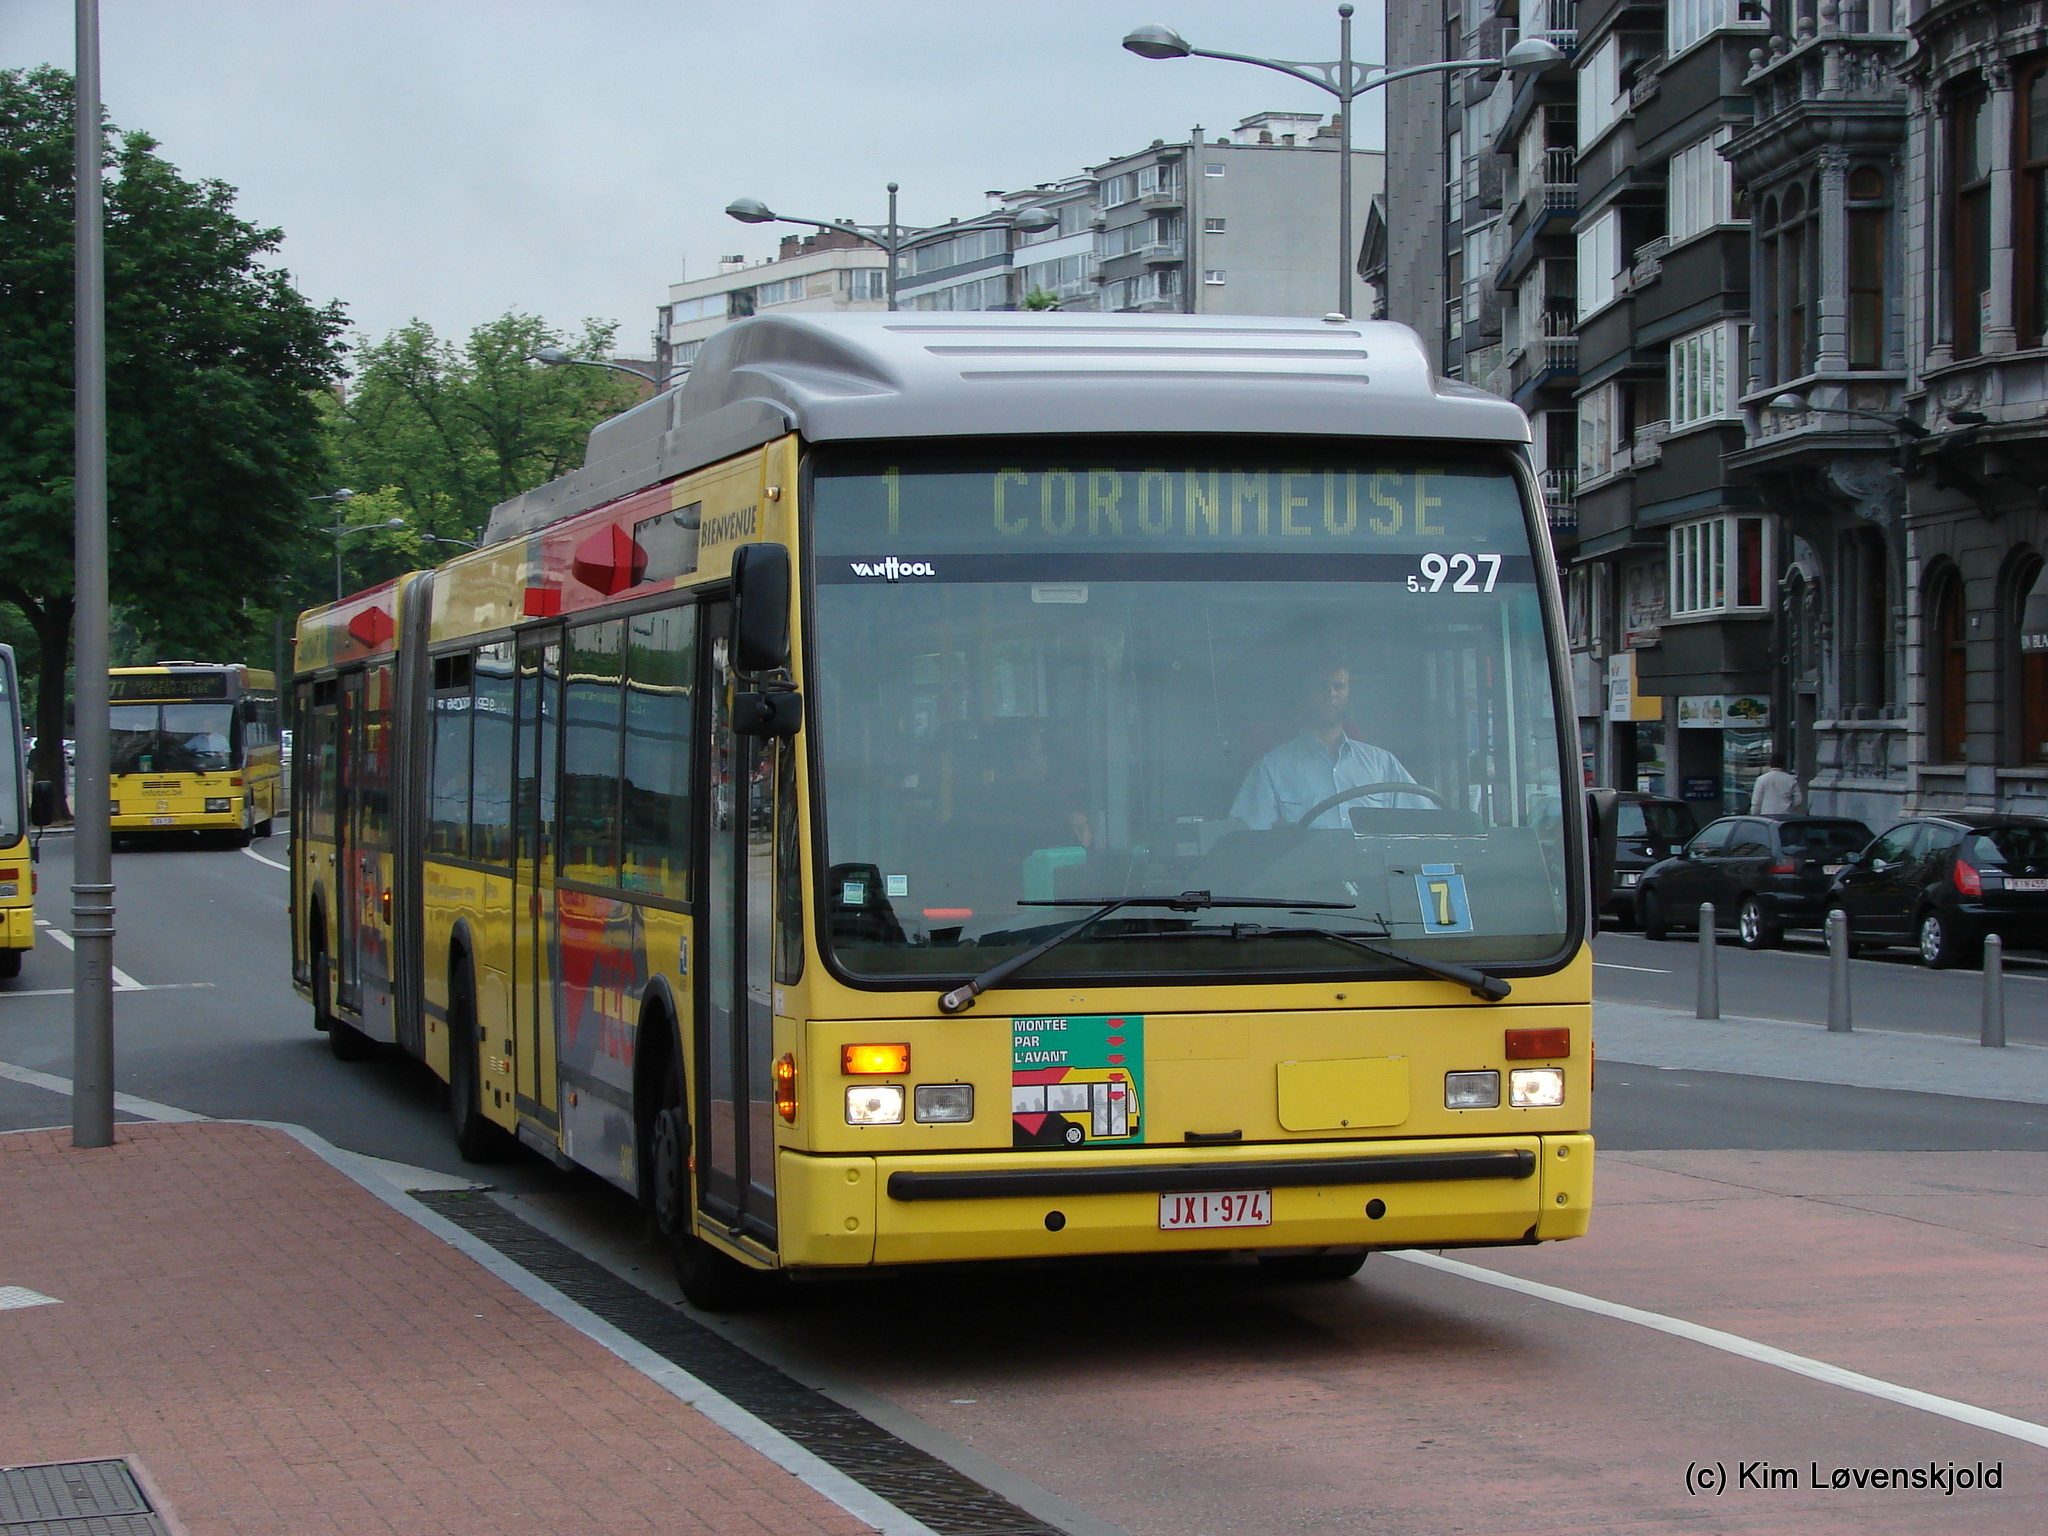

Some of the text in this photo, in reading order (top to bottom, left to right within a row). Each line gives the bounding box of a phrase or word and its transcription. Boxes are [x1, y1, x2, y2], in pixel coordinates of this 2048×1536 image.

[881, 466, 1446, 537] 1 CORONMEUSE
[701, 505, 757, 548] BIENVENUE
[1406, 553, 1502, 592] 5.927
[1430, 883, 1449, 924] 7
[1014, 1017, 1068, 1031] MONTÉE
[1014, 1036, 1040, 1047] PAR
[1014, 1051, 1068, 1063] L'AVANT
